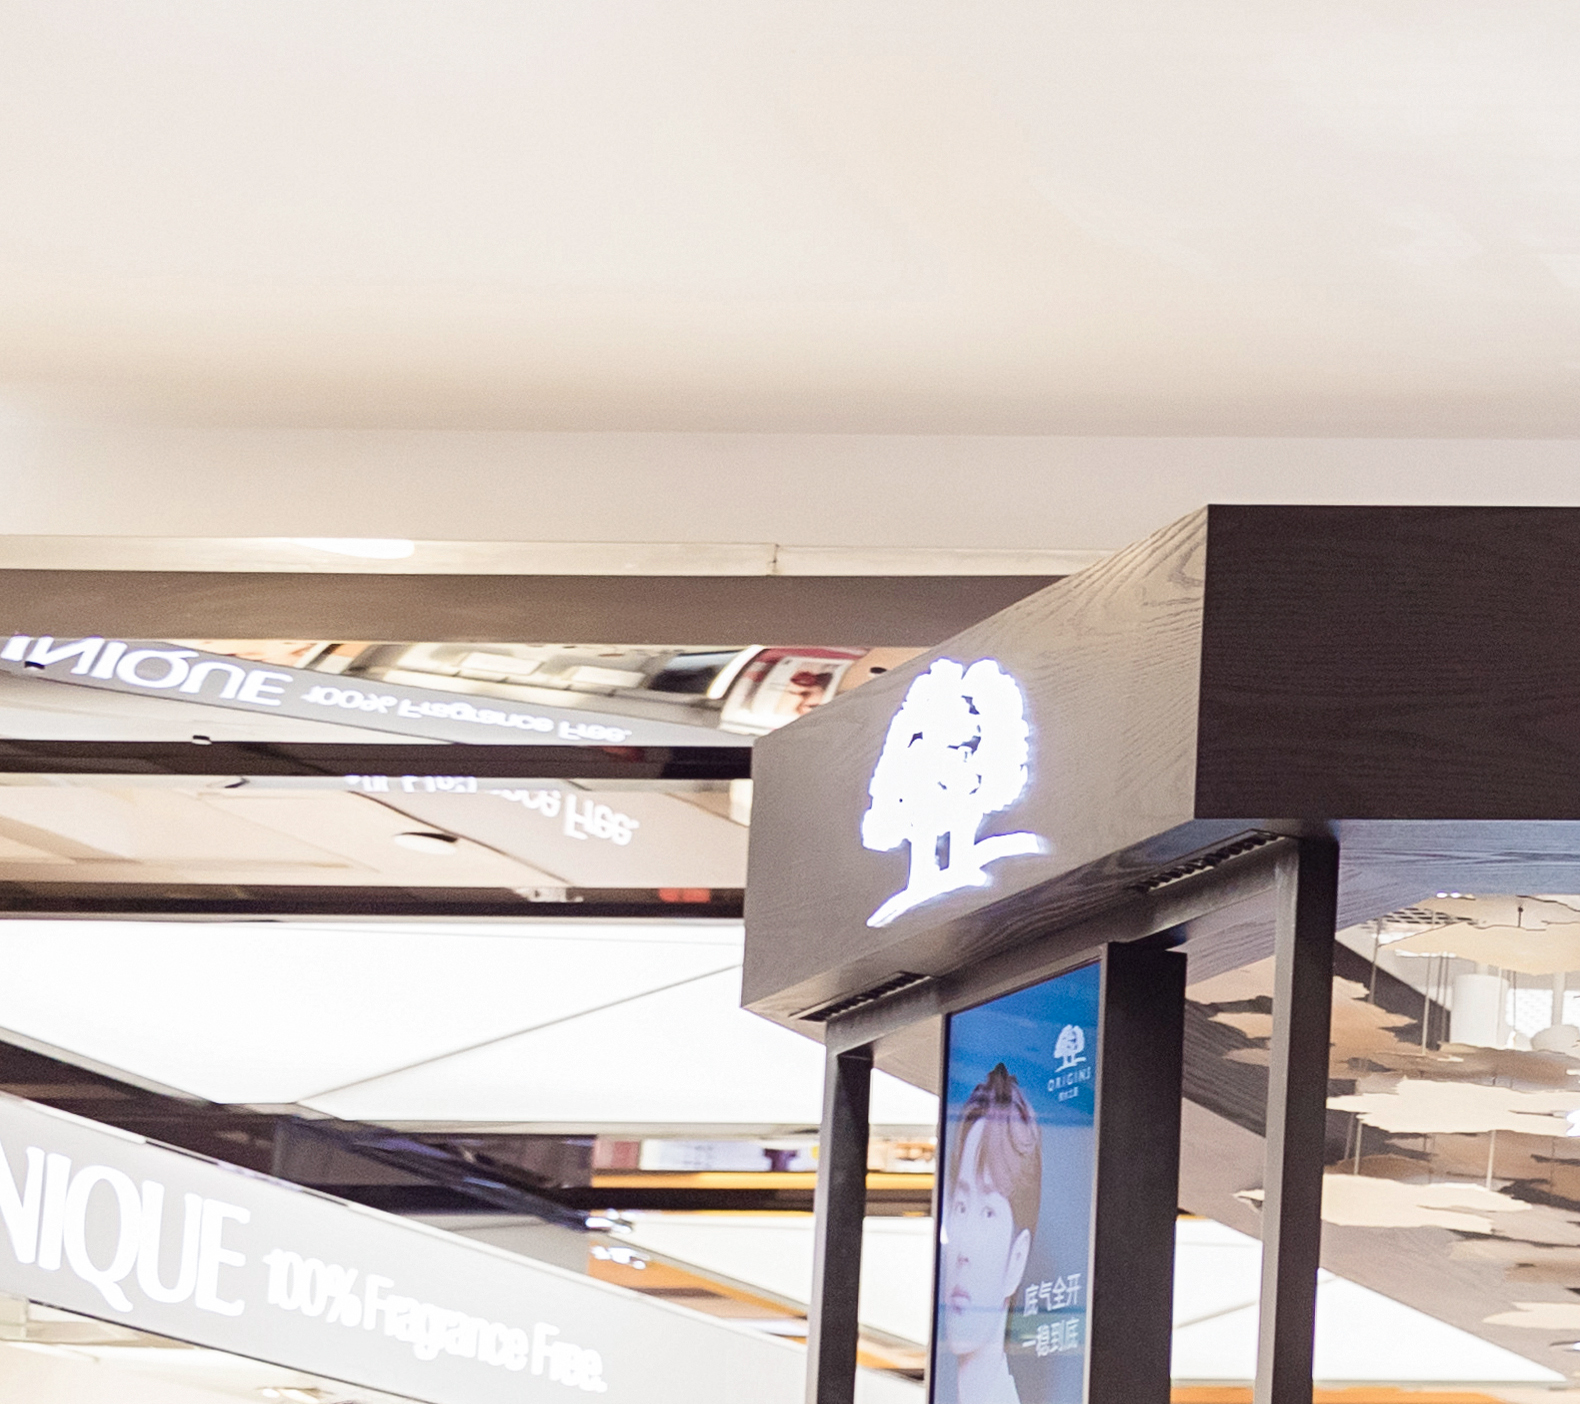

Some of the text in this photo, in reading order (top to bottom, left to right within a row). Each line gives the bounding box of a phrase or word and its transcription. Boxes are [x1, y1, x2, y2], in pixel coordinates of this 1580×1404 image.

[1047, 1066, 1091, 1092] ORIGINS
[1023, 1273, 1081, 1317] 底气全开
[361, 1273, 529, 1371] Fragrance
